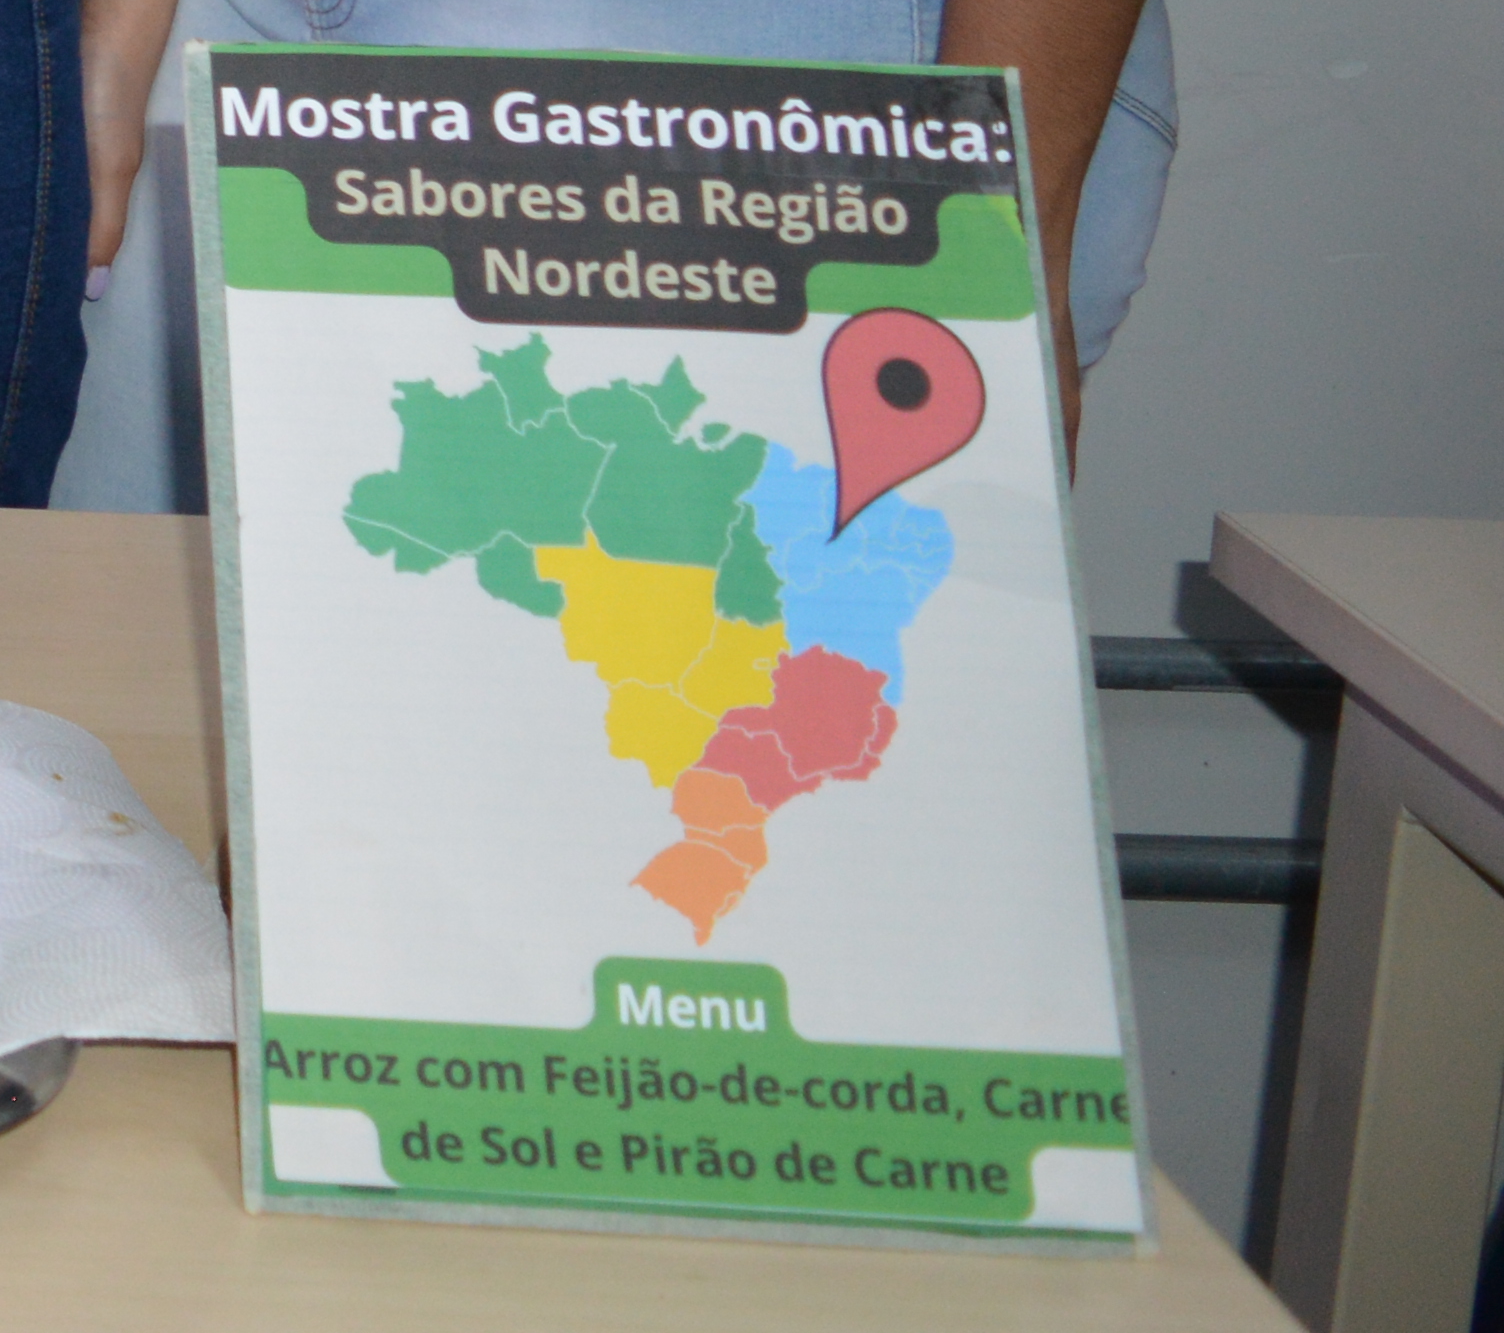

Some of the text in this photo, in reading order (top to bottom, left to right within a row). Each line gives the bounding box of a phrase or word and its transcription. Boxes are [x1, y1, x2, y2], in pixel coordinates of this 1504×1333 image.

[219, 86, 1013, 165] Mostra Gastronômica:
[334, 167, 910, 244] Sabores da Região
[483, 247, 778, 306] Nordeste
[617, 983, 767, 1033] Menu
[264, 1038, 1132, 1126] Arroz com Feijão-de-corda, Carne
[402, 1120, 1009, 1197] de Sol e Pirão de Carne
